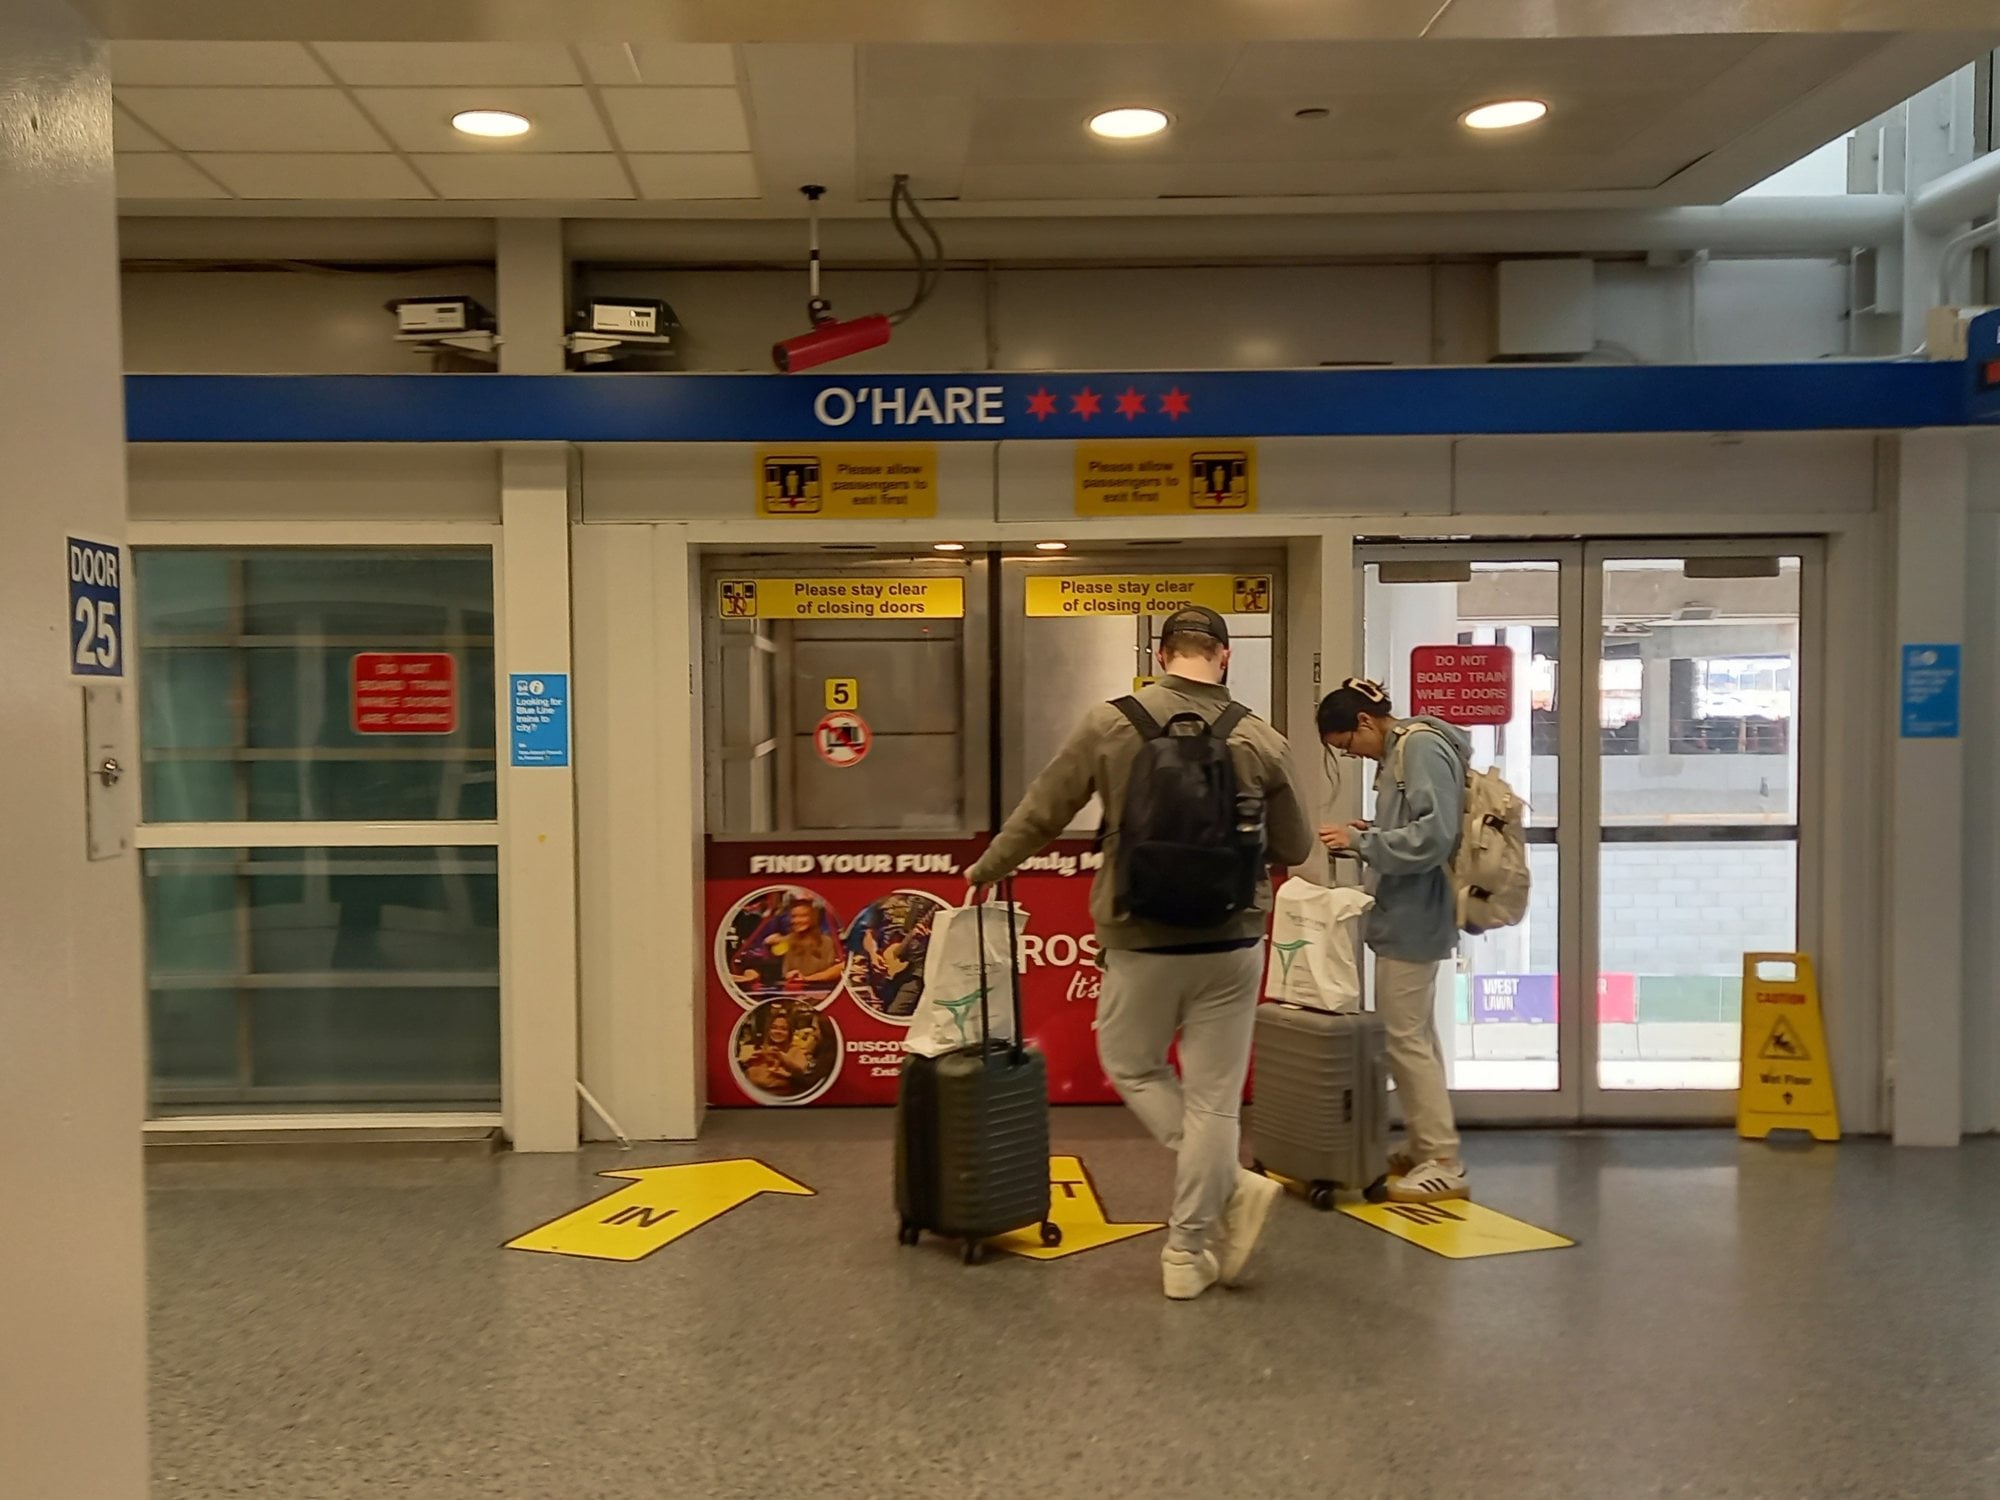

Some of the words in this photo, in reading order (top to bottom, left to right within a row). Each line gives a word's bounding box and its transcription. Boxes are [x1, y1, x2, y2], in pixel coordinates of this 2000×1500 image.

[814, 386, 1005, 426] O'HARE
[71, 545, 118, 588] DOOR
[794, 583, 846, 596] Please
[851, 583, 883, 599] stay
[888, 583, 928, 595] clear
[1060, 580, 1113, 594] Please
[1117, 581, 1150, 596] stay
[1155, 580, 1195, 593] clear
[797, 601, 813, 614] of
[817, 601, 874, 616] closing
[879, 601, 925, 614] doors
[1063, 599, 1080, 612] of
[1083, 598, 1141, 614] closing
[1146, 598, 1191, 611] doors
[75, 596, 117, 669] 25
[1435, 655, 1455, 666] DO
[1461, 655, 1488, 666] NOT
[1416, 672, 1461, 683] BOARD
[1468, 672, 1507, 683] TRAIN
[833, 683, 850, 705] 5
[1416, 689, 1456, 700] WHILE
[1461, 688, 1507, 699] DOORS
[1419, 705, 1445, 716] ARE
[1450, 705, 1506, 716] CLOSING
[750, 854, 816, 874] FIND
[817, 854, 893, 874] YOUR
[896, 853, 960, 875] FUN,
[1482, 978, 1520, 995] WEST
[1484, 995, 1514, 1011] LAWN
[598, 1206, 680, 1228] IN
[1382, 1202, 1467, 1225] IN
